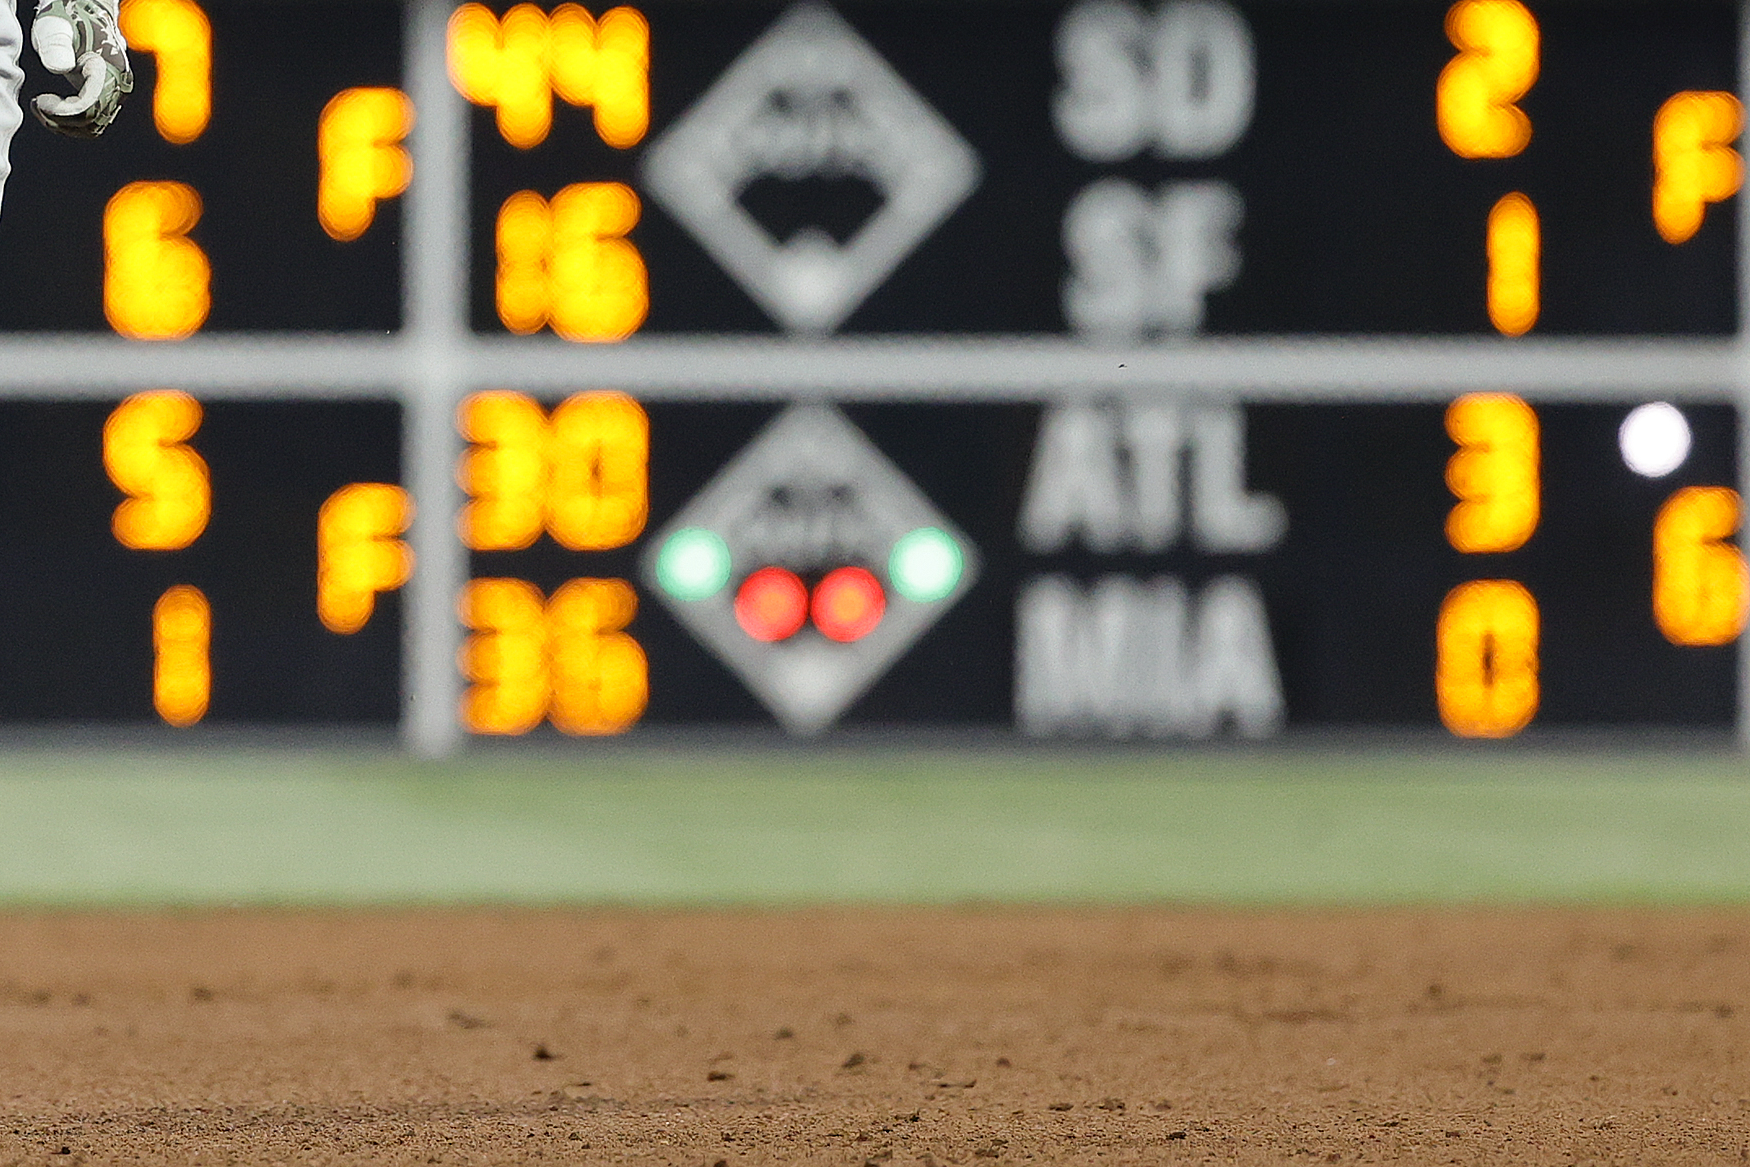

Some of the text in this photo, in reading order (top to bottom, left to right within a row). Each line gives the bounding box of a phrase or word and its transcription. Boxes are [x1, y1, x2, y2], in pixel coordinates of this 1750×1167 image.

[446, 2, 650, 149] 44
[317, 86, 417, 241] F
[1652, 90, 1746, 244] F
[103, 180, 212, 341] 6
[1062, 179, 1243, 336] SF
[1486, 192, 1541, 338] 1
[103, 389, 212, 551] 5
[456, 389, 650, 551] 30
[1018, 396, 1288, 555] ATL
[1445, 391, 1541, 553] 3
[317, 482, 416, 634] F
[1653, 485, 1749, 646] 6
[153, 584, 212, 727] 1
[458, 573, 1541, 739] 36 MIA 0
